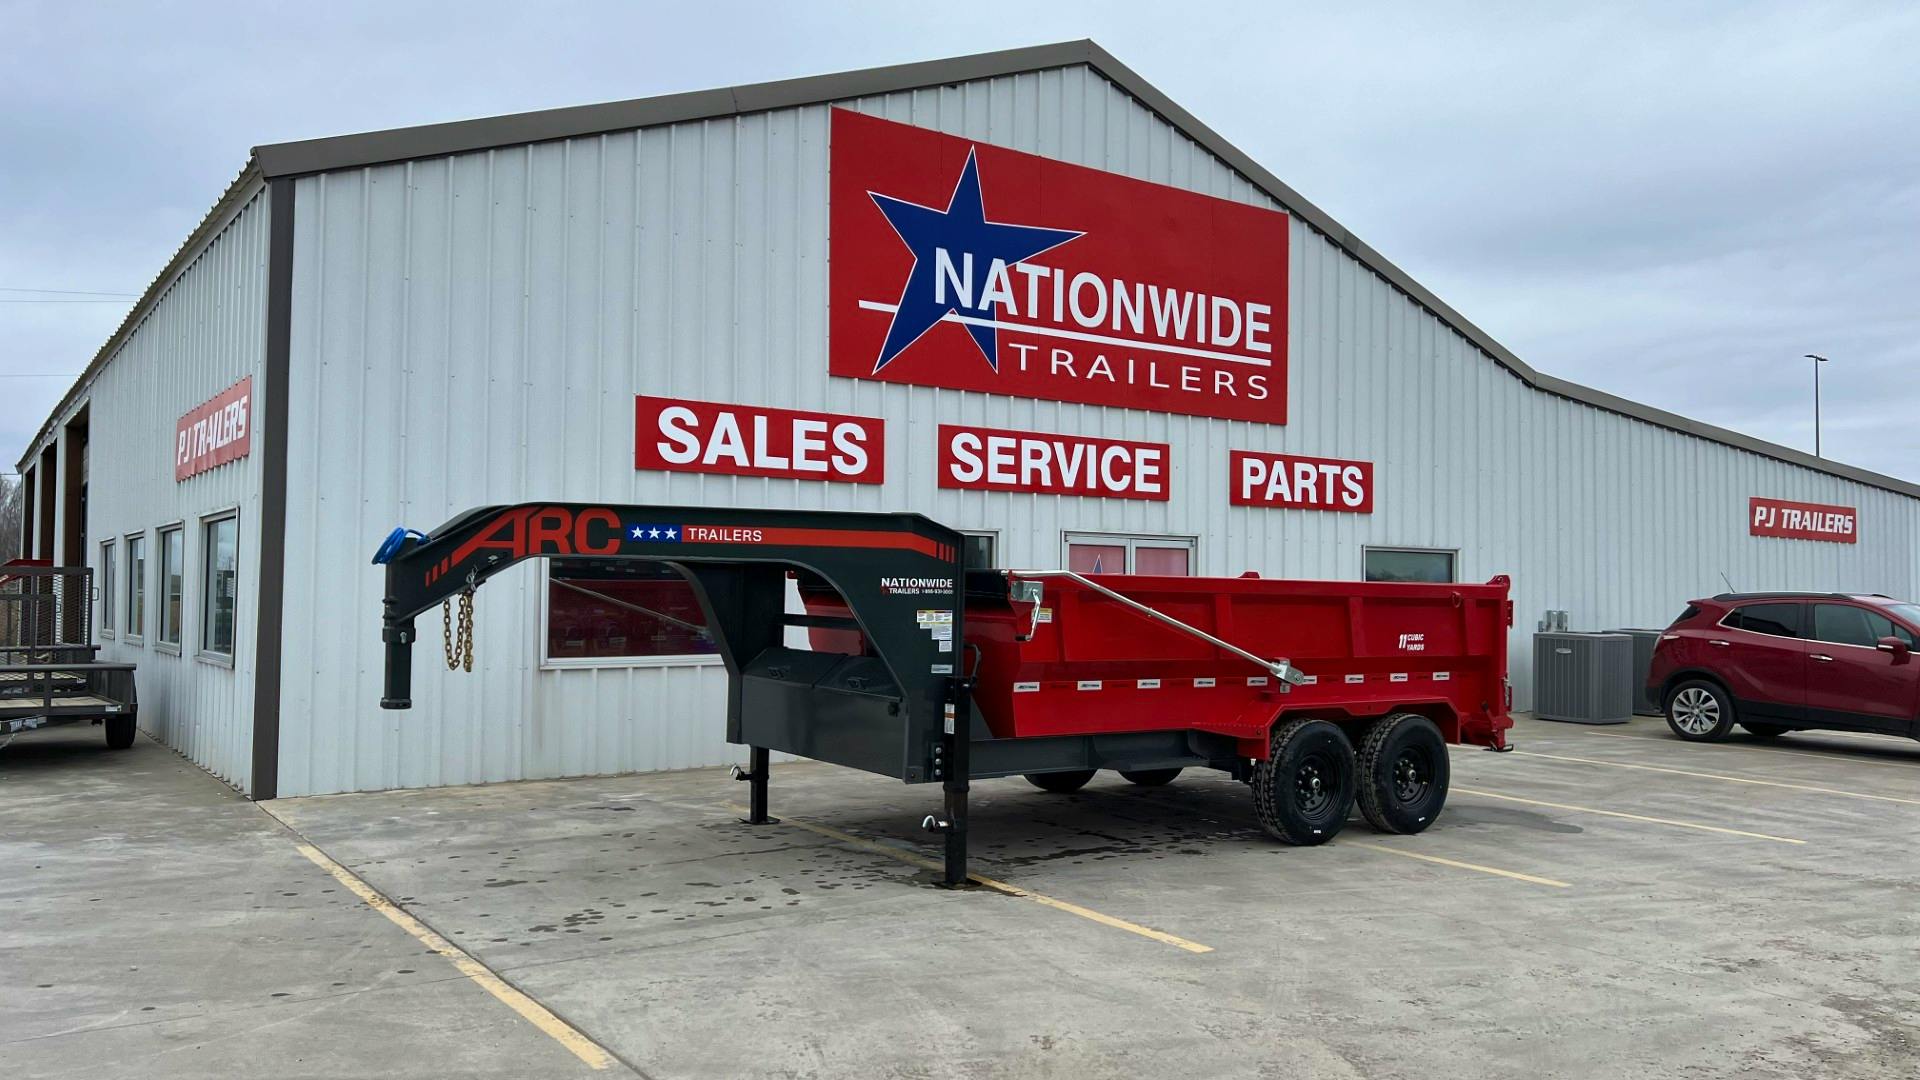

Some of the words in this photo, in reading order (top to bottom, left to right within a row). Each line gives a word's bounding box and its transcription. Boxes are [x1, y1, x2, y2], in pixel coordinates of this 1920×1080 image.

[935, 247, 1272, 353] NATIONWIDE
[1008, 343, 1269, 401] TRAILERS
[177, 427, 191, 466] PJ
[193, 395, 248, 459] TRAILERS
[656, 406, 869, 476] SALES
[950, 432, 1161, 494] SERVICE
[1242, 458, 1365, 507] PARTS
[451, 507, 621, 560] ARC
[688, 527, 763, 542] TRAILERS
[1754, 506, 1776, 528] PJ
[1781, 508, 1854, 534] TRAILERS
[881, 577, 953, 588] NATIONWIDE
